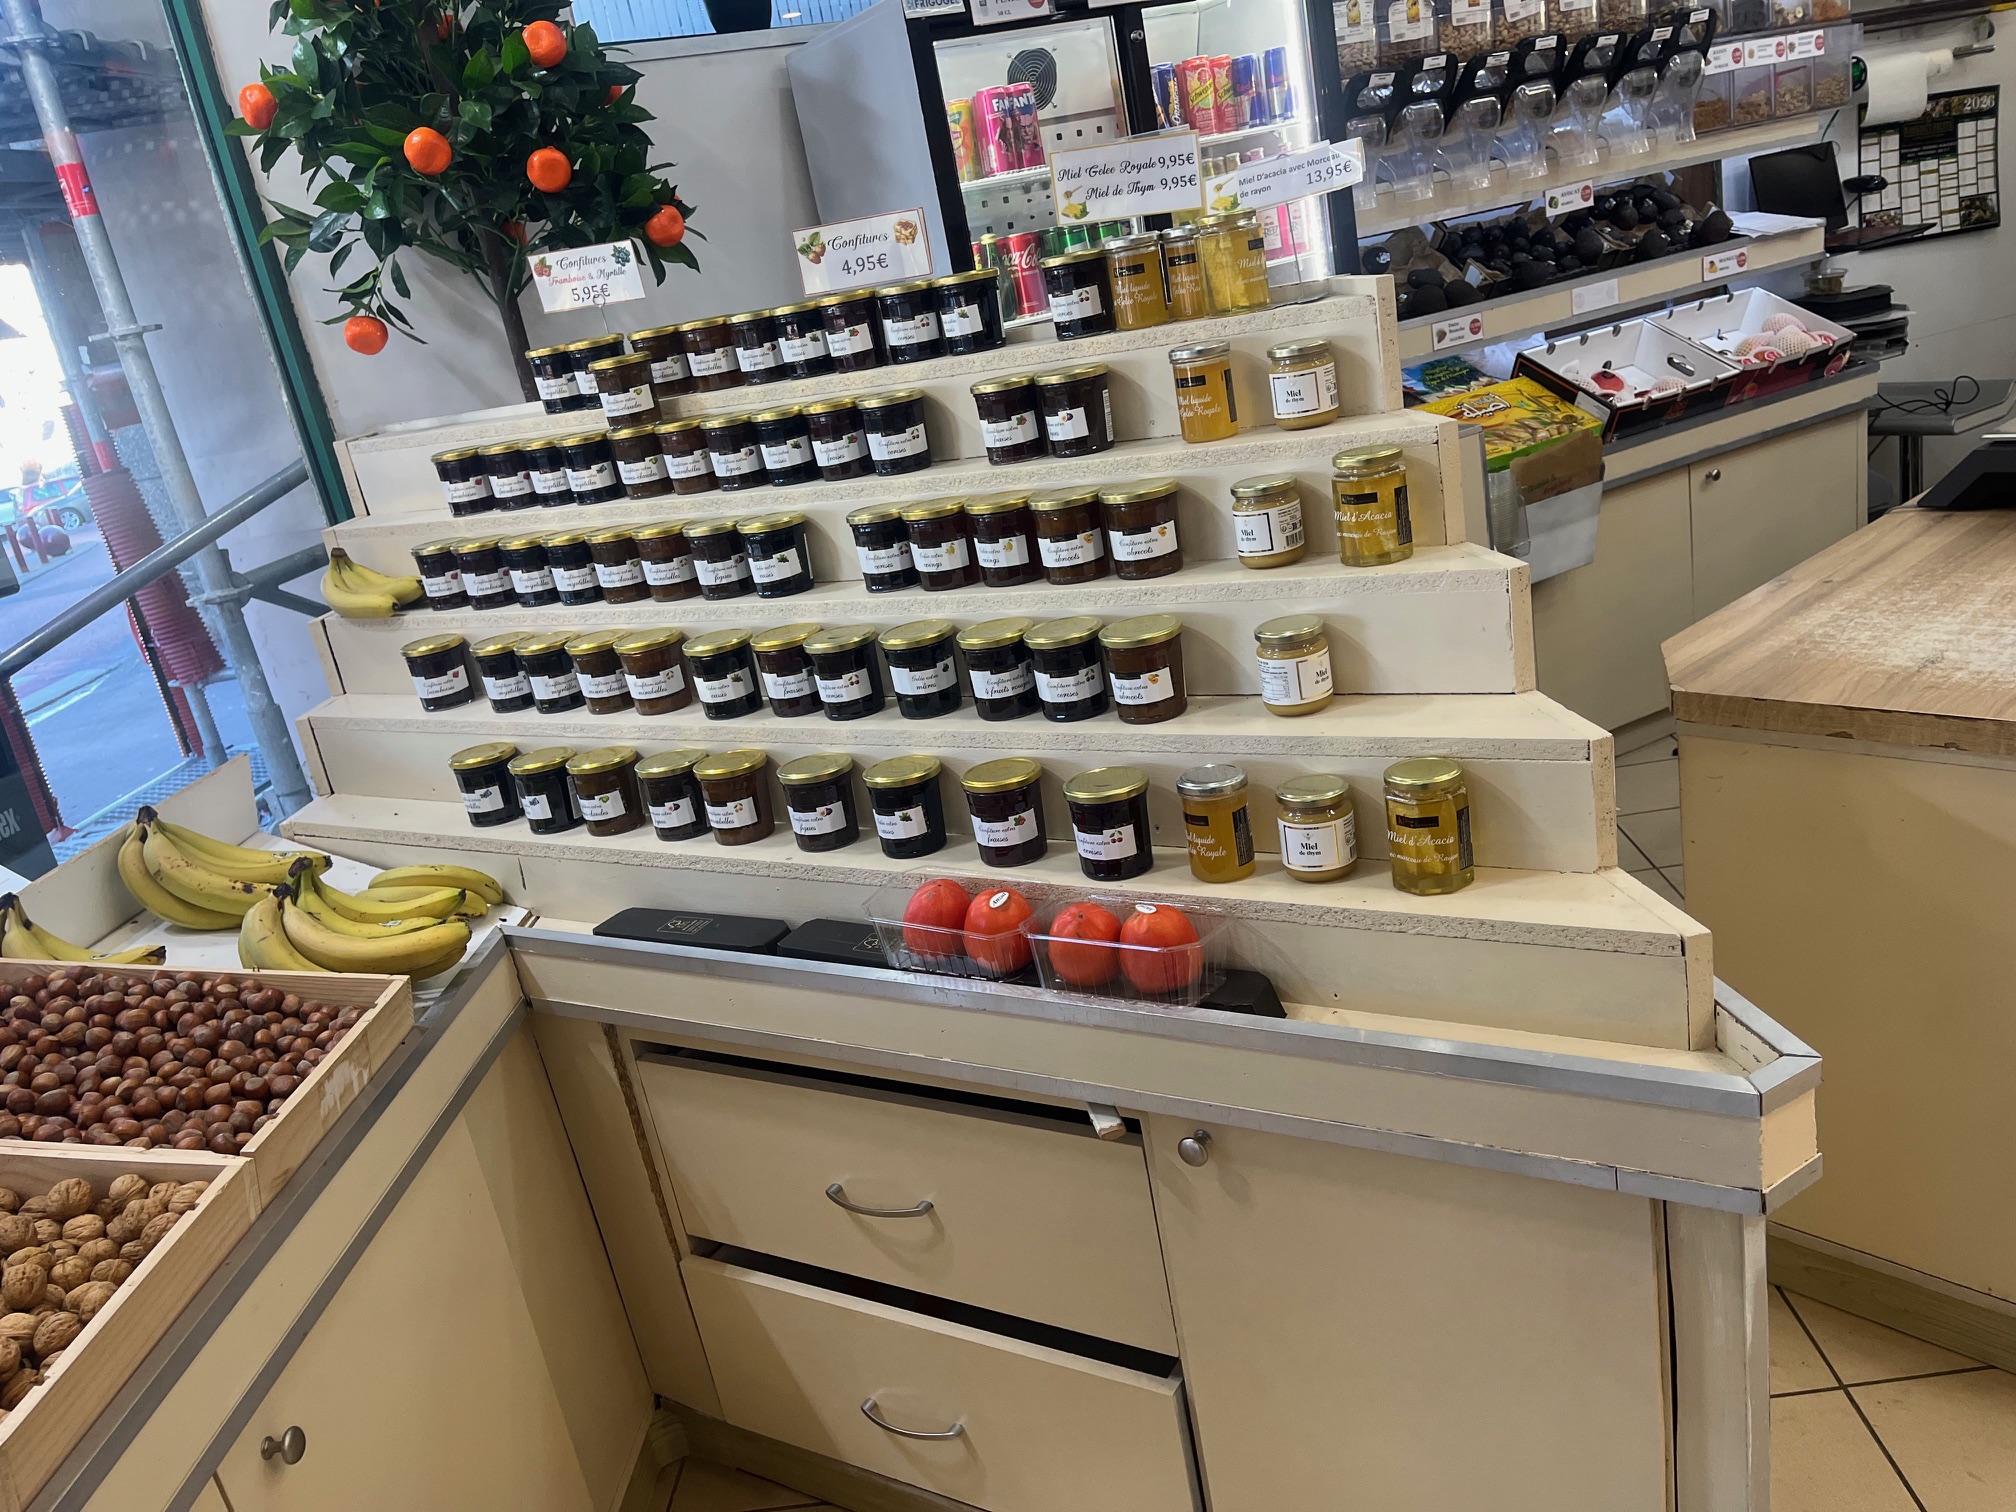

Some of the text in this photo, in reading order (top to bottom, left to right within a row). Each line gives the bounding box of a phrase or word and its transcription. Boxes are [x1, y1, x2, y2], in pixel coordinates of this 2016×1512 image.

[1963, 94, 1996, 111] 2026
[1057, 168, 1082, 182] Miel
[1119, 157, 1157, 175] Royale
[1158, 152, 1195, 169] 9,95€
[1238, 152, 1341, 187] Miel D'acacia avec Morceau
[1306, 160, 1353, 186] 13,95€
[1085, 174, 1197, 200] Miel de Thym 9,95€
[1239, 184, 1273, 199] de rayon
[827, 231, 891, 252] Confitures
[556, 255, 608, 271] Confitures
[842, 253, 889, 277] 4,95€
[549, 266, 627, 287] Framboise & Myrtille
[571, 283, 611, 303] 5,95€
[1286, 389, 1302, 397] Miel
[1054, 553, 1080, 564] abricots
[1126, 546, 1154, 557] abricots
[990, 685, 1010, 697] fruits
[1056, 690, 1079, 698] cerises
[987, 834, 1009, 845] fraises
[1193, 837, 1216, 847] liquide
[1387, 830, 1408, 845] Miel
[1083, 848, 1103, 856] cerises
[1197, 845, 1228, 861] Royale
[1300, 842, 1319, 850] Miel
